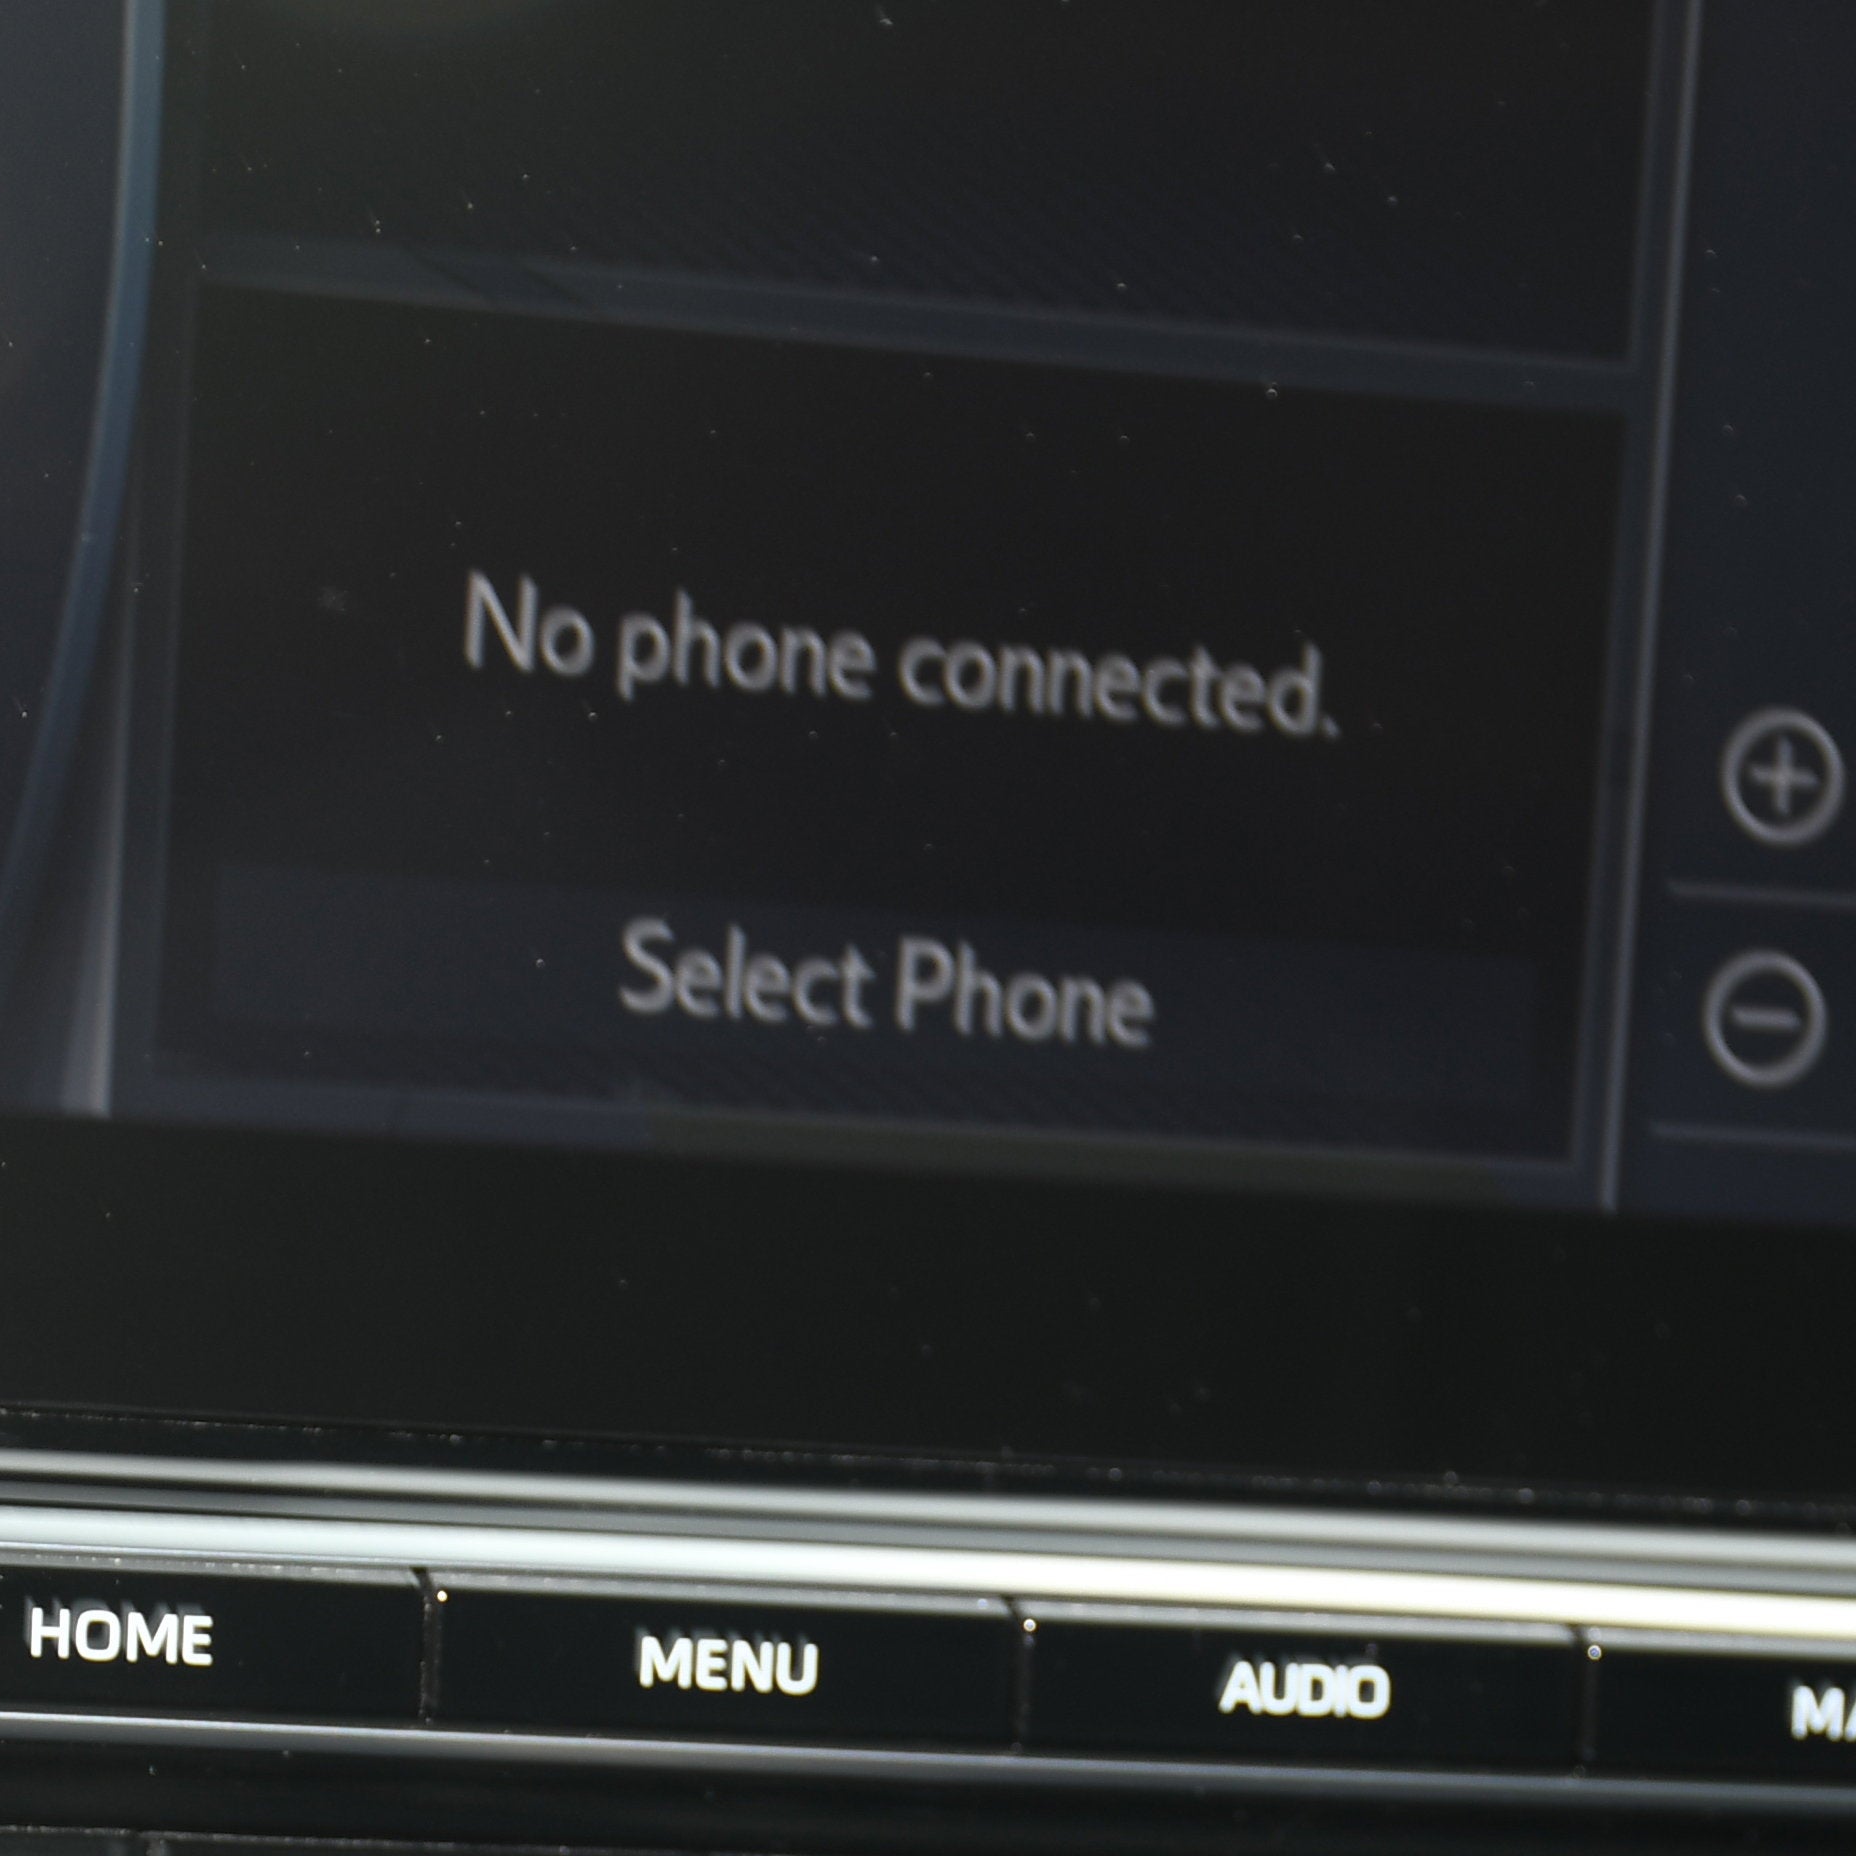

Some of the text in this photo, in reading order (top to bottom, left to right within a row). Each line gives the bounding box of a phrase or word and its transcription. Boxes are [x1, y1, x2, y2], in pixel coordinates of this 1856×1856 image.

[464, 571, 1341, 738] No phone connected.
[620, 918, 1155, 1048] Select Phone
[27, 1604, 215, 1668] HOME
[637, 1632, 821, 1697] MENU
[1218, 1659, 1392, 1720] AUDIO
